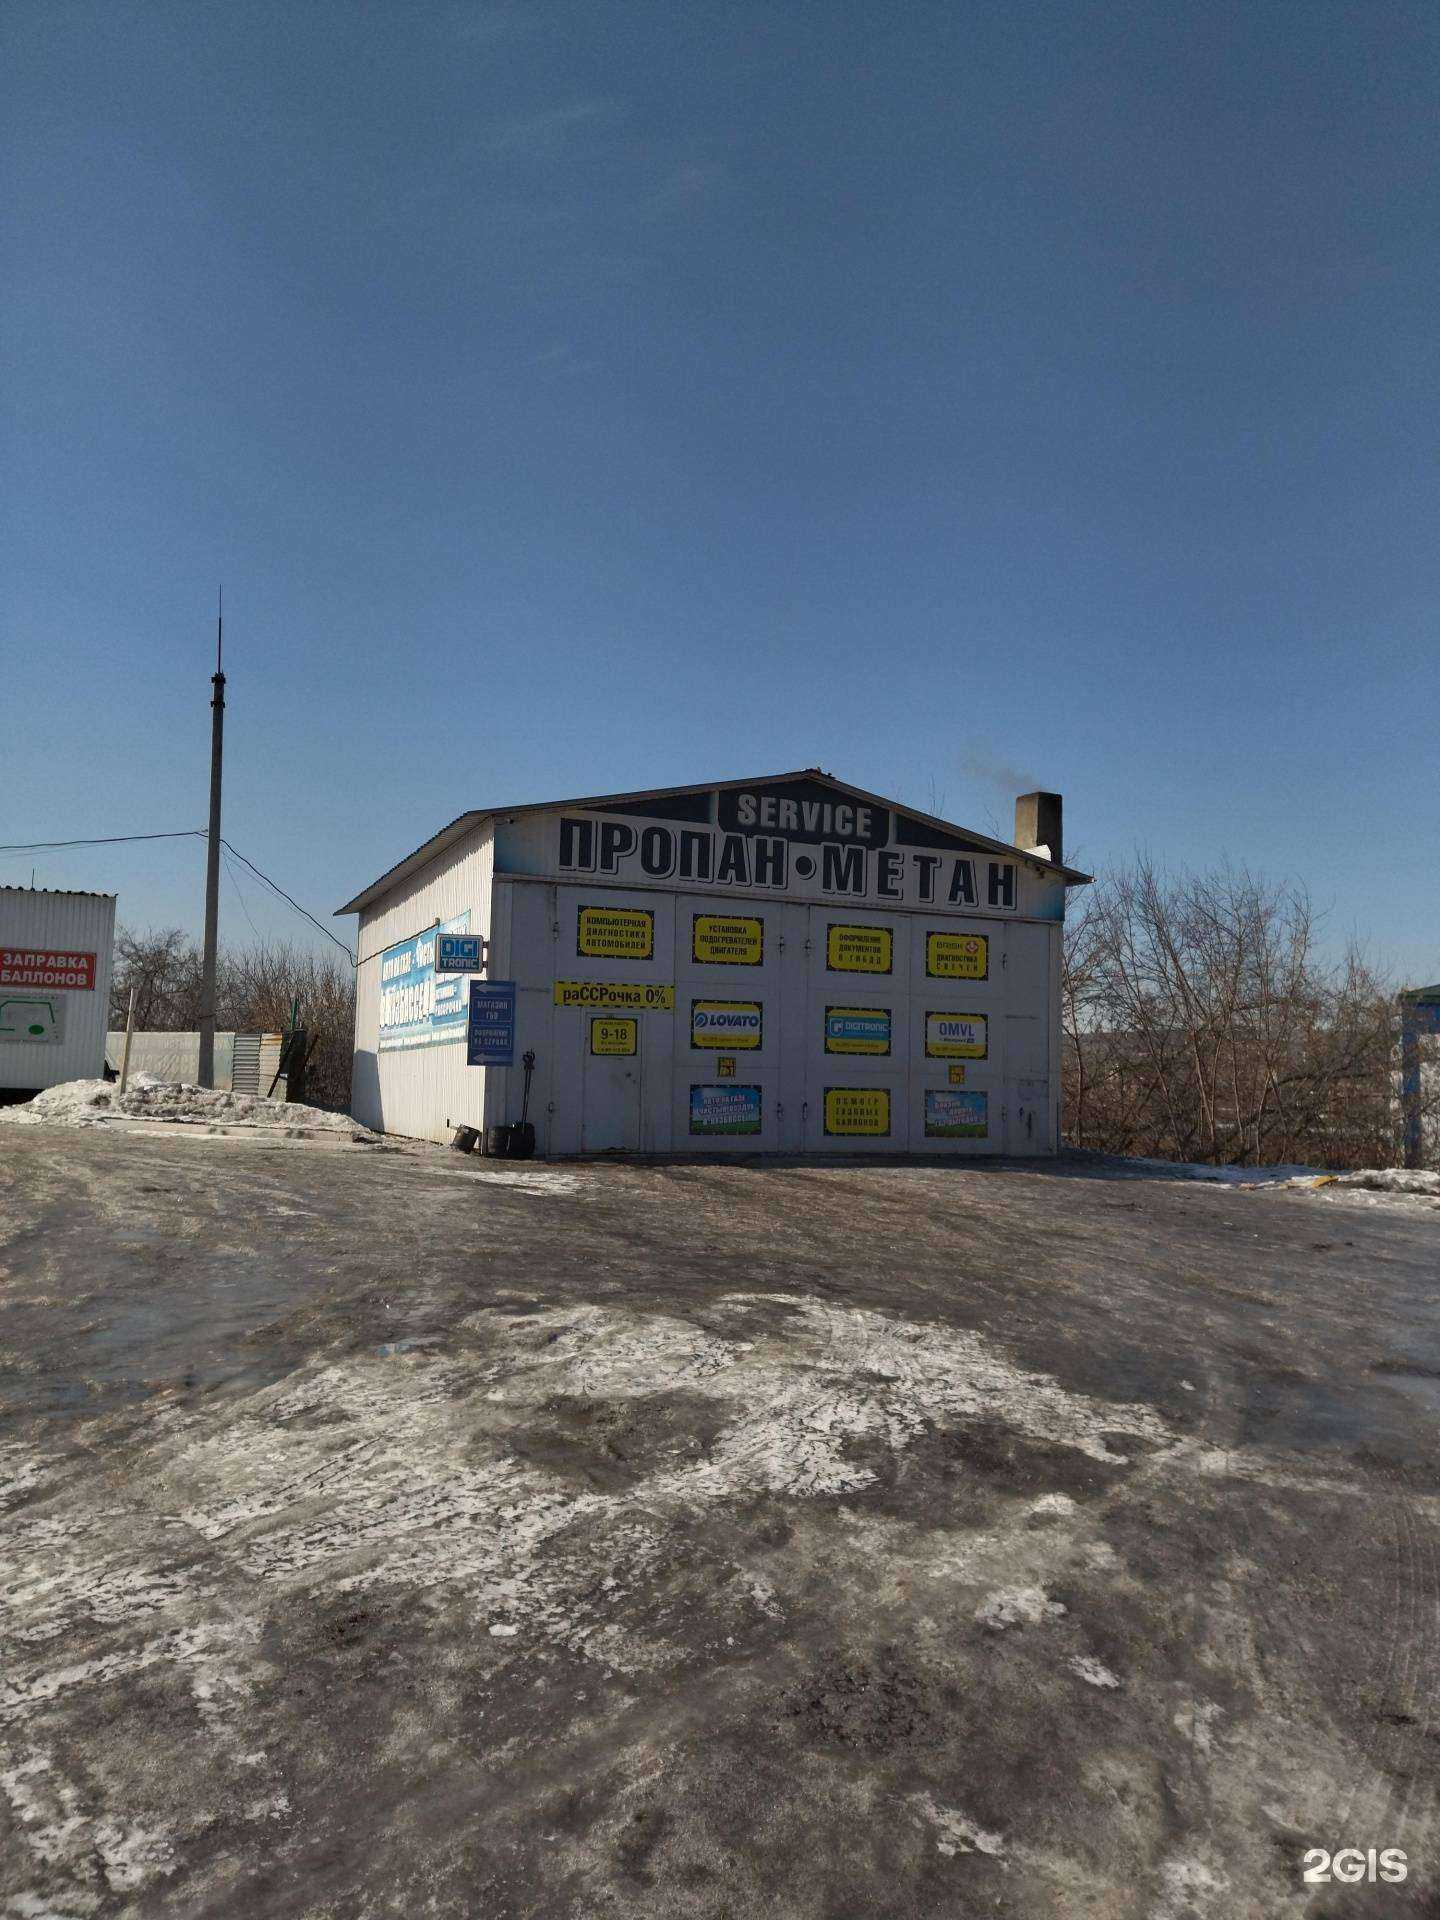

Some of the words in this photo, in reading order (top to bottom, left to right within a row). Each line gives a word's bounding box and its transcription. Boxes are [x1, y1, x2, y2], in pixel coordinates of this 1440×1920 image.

[737, 793, 872, 839] SERVICE
[559, 817, 789, 889] ПРОПАН
[822, 843, 1017, 911] МЕТАН
[586, 917, 646, 928] КОМПЬЮТЕРНАЯ
[586, 928, 646, 939] ДИАГНОСТИКА
[709, 925, 747, 935] УСТАНОВКА
[586, 938, 646, 949] АВТОМОБИЛЕЙ
[699, 935, 758, 945] ПОДОГРЕВАТЕЛЕЙ
[441, 939, 478, 957] DIGI
[710, 946, 748, 956] ДВИГАТЕЛЯ
[2, 952, 88, 969] ЗАПРАВКА
[442, 958, 478, 968] TRONIC
[0, 969, 87, 986] БАЛЛОНОВ
[563, 986, 641, 1003] раССРочка
[645, 988, 666, 1004] 0%
[477, 1000, 508, 1009] МАГАЗИН
[709, 1014, 759, 1027] LOVATO
[601, 1027, 627, 1040] 9-18
[939, 1022, 975, 1037] OMVL
